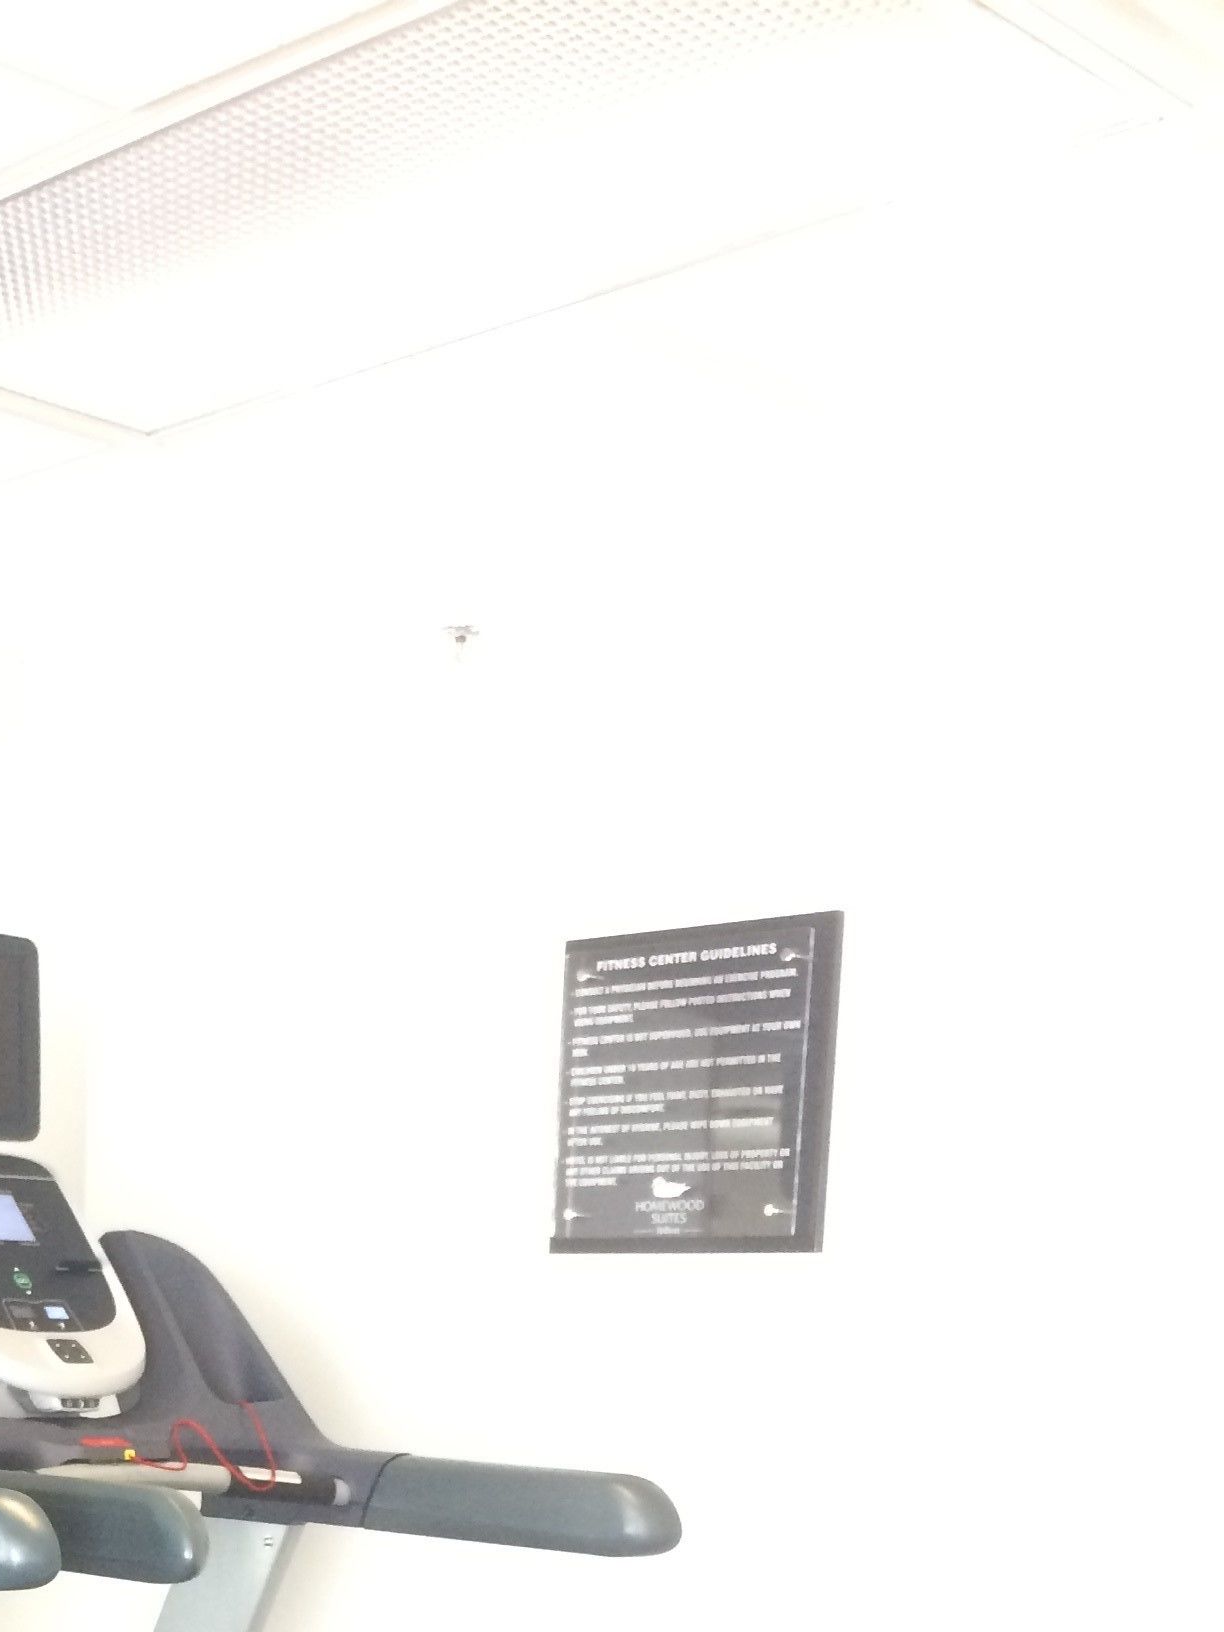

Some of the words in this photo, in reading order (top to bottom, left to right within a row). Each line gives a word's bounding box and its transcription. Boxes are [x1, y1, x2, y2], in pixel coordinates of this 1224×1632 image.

[596, 956, 646, 972] FITNESS
[648, 951, 697, 967] CENTER
[700, 942, 778, 962] GUIDELINES
